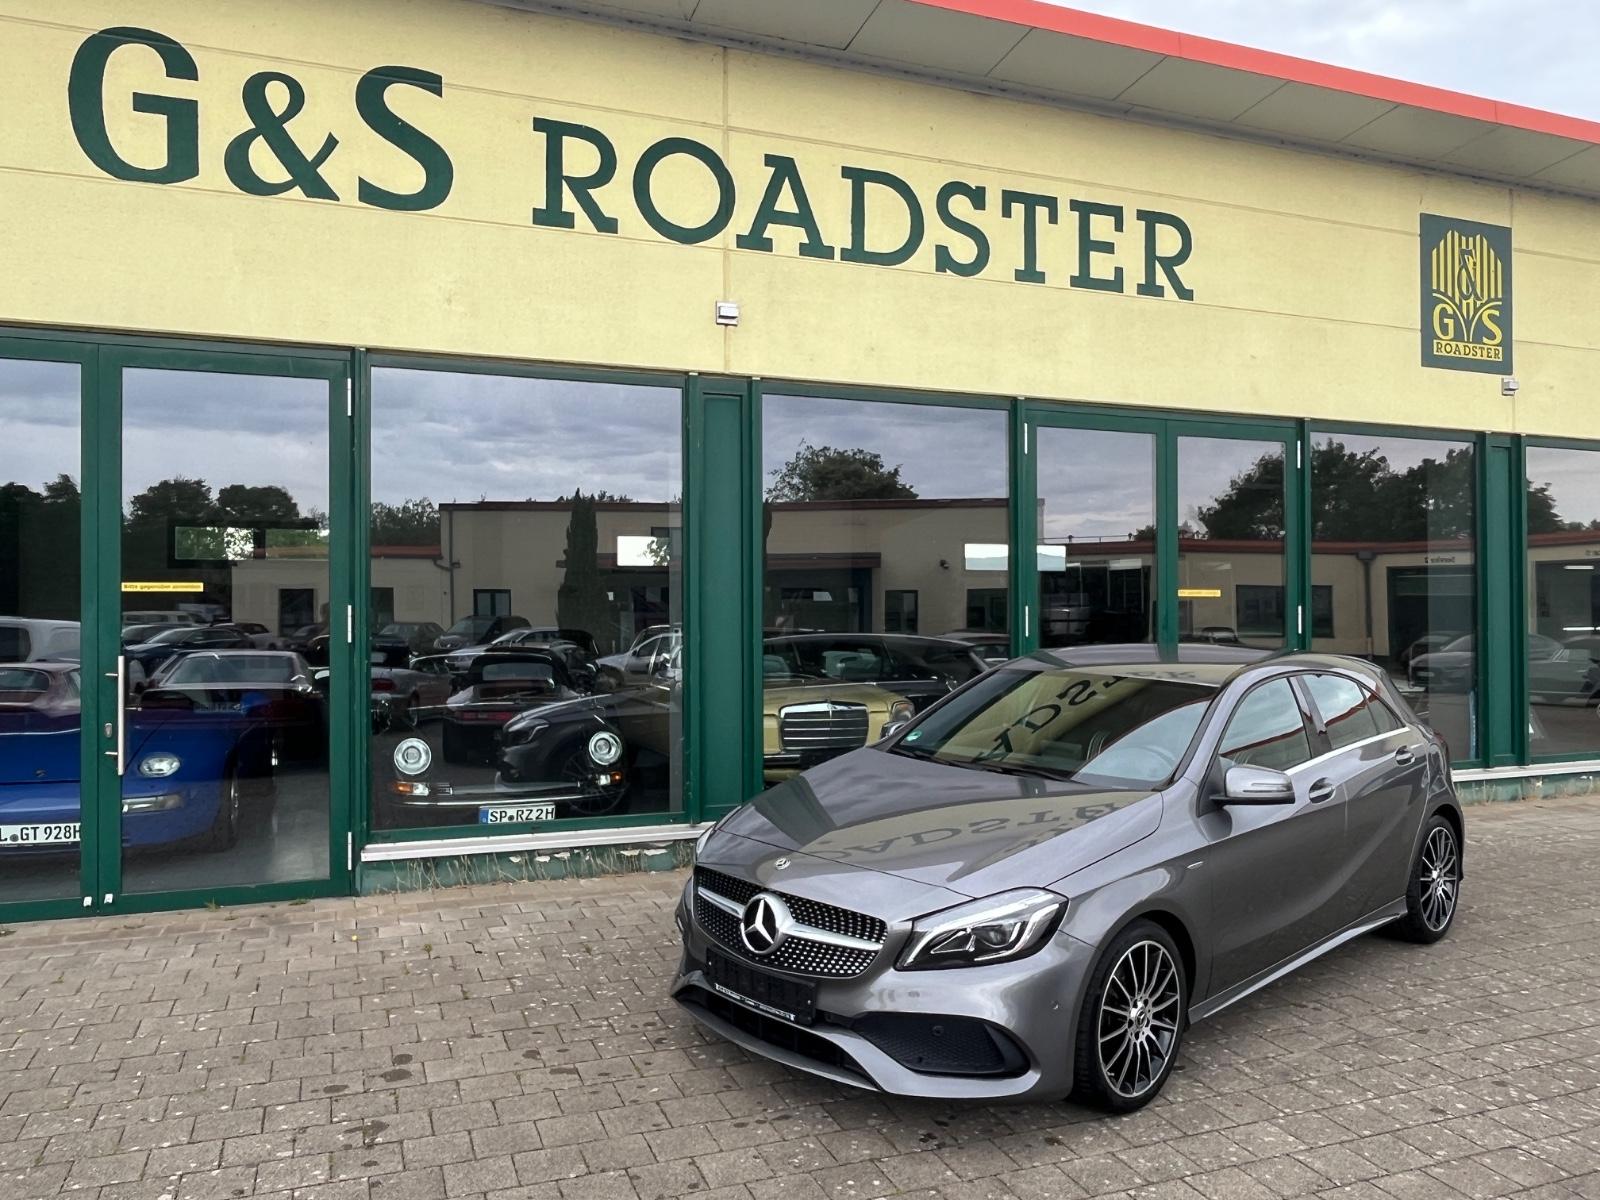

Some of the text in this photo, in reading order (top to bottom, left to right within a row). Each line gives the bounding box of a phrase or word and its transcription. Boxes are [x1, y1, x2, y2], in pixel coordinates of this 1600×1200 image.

[68, 26, 1194, 301] G&S ROADSTER
[1435, 341, 1501, 359] ROADSTER
